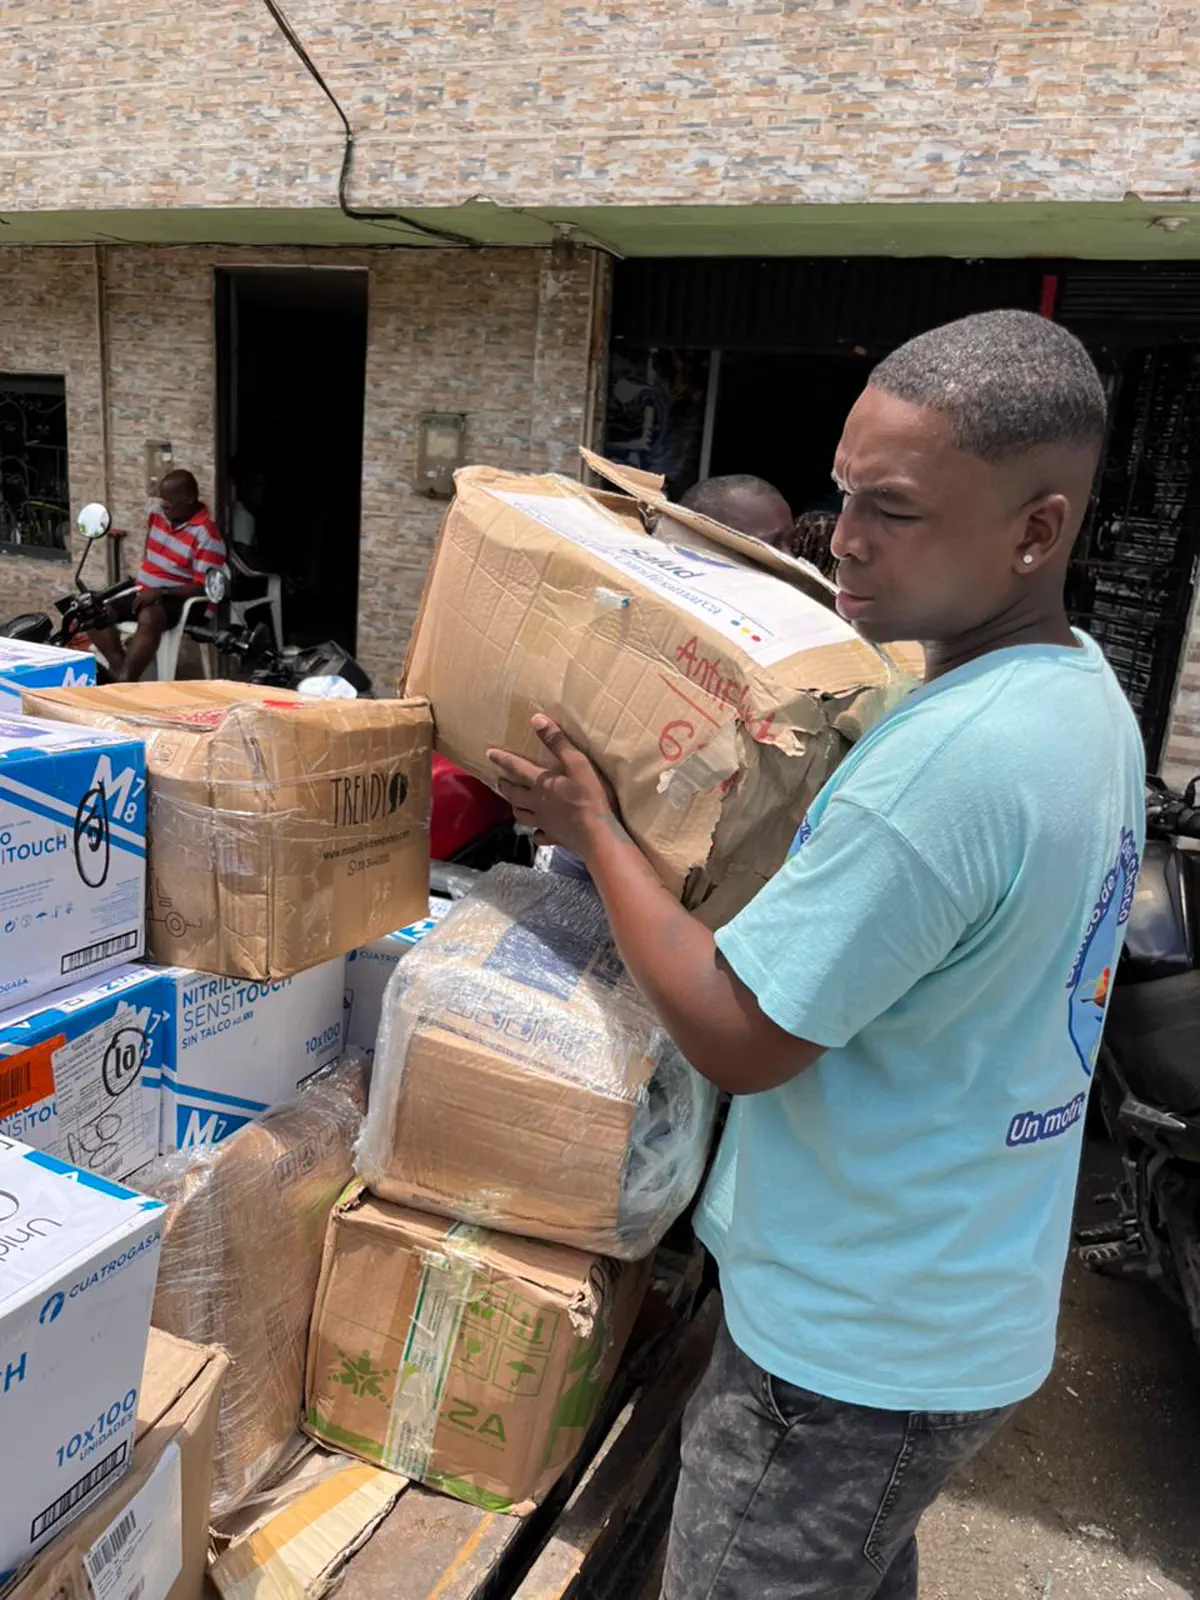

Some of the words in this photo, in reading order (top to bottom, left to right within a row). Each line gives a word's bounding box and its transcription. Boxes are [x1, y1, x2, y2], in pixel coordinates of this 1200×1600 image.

[659, 719, 694, 761] 6
[86, 754, 136, 820] M
[132, 777, 145, 798] 7
[330, 771, 390, 829] TRENDY
[123, 802, 137, 823] 8
[181, 1036, 198, 1049] SIN
[200, 1019, 231, 1040] TALCO
[215, 1120, 227, 1140] 7
[1010, 1117, 1039, 1141] Un
[68, 1229, 161, 1298] CUATROGASA
[56, 1388, 137, 1468] 10x100
[79, 1411, 134, 1461] UNIDADES
